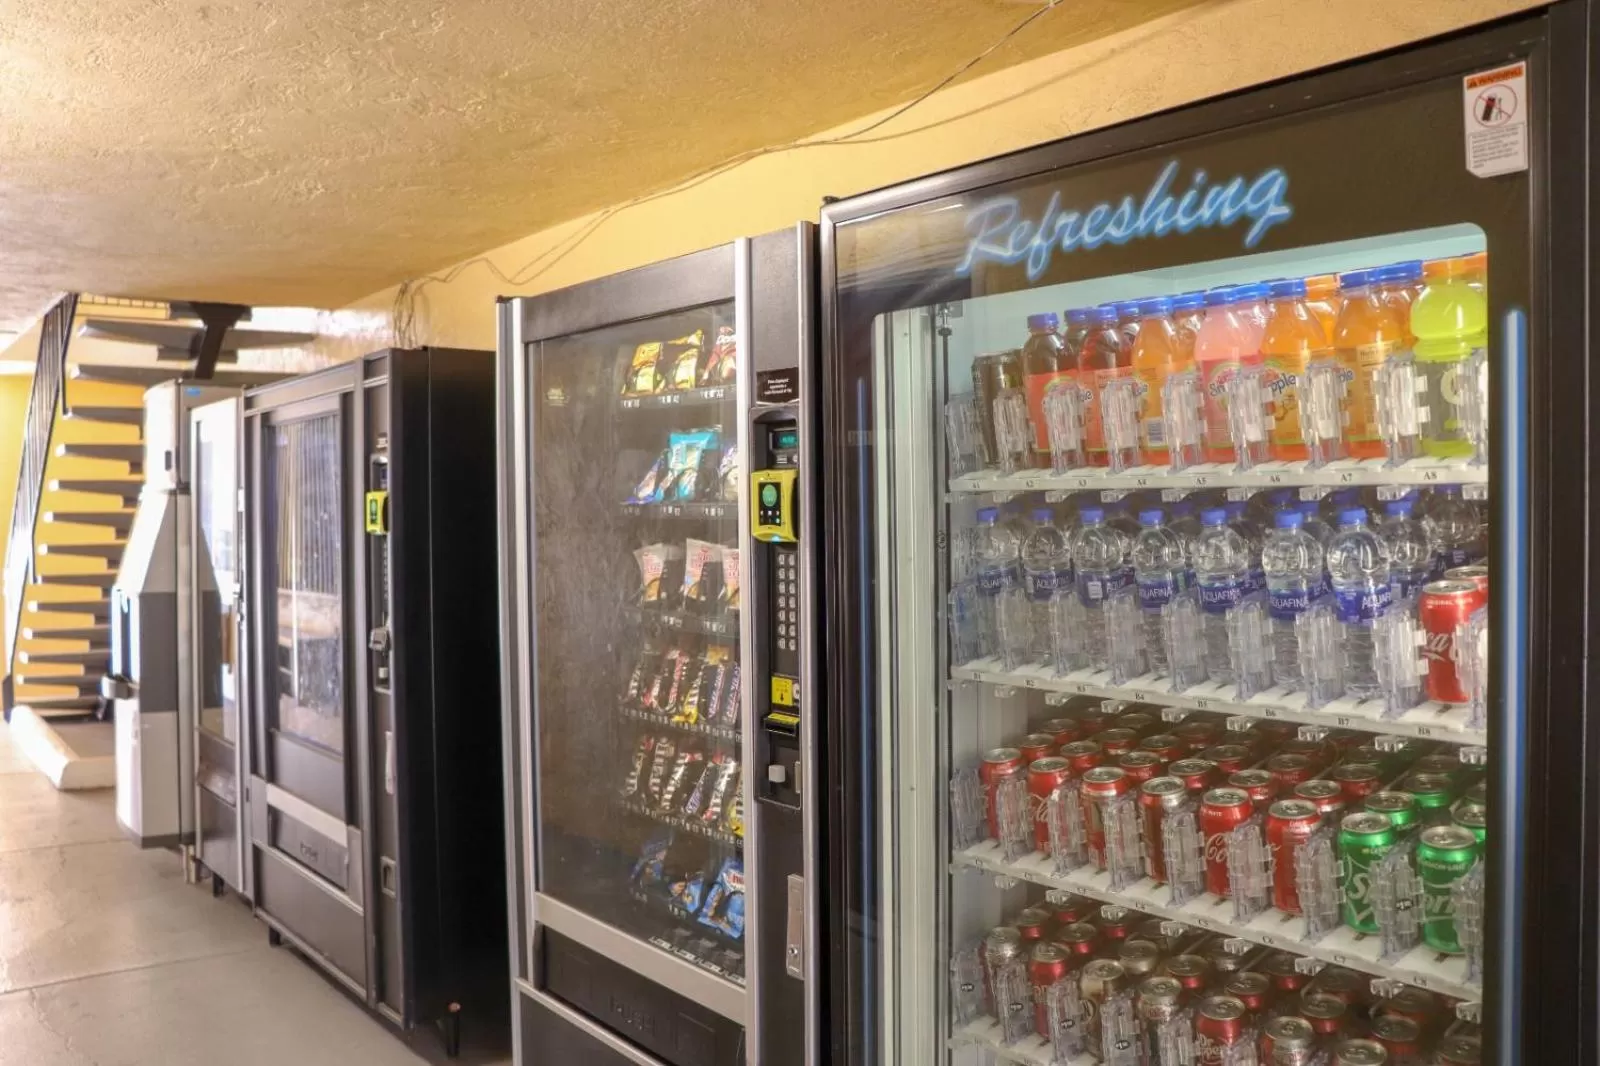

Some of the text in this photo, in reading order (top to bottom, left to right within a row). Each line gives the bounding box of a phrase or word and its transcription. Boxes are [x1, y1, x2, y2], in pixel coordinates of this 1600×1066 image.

[954, 159, 1292, 282] Refreshing
[1341, 473, 1352, 482] A7
[1424, 471, 1437, 480] A8
